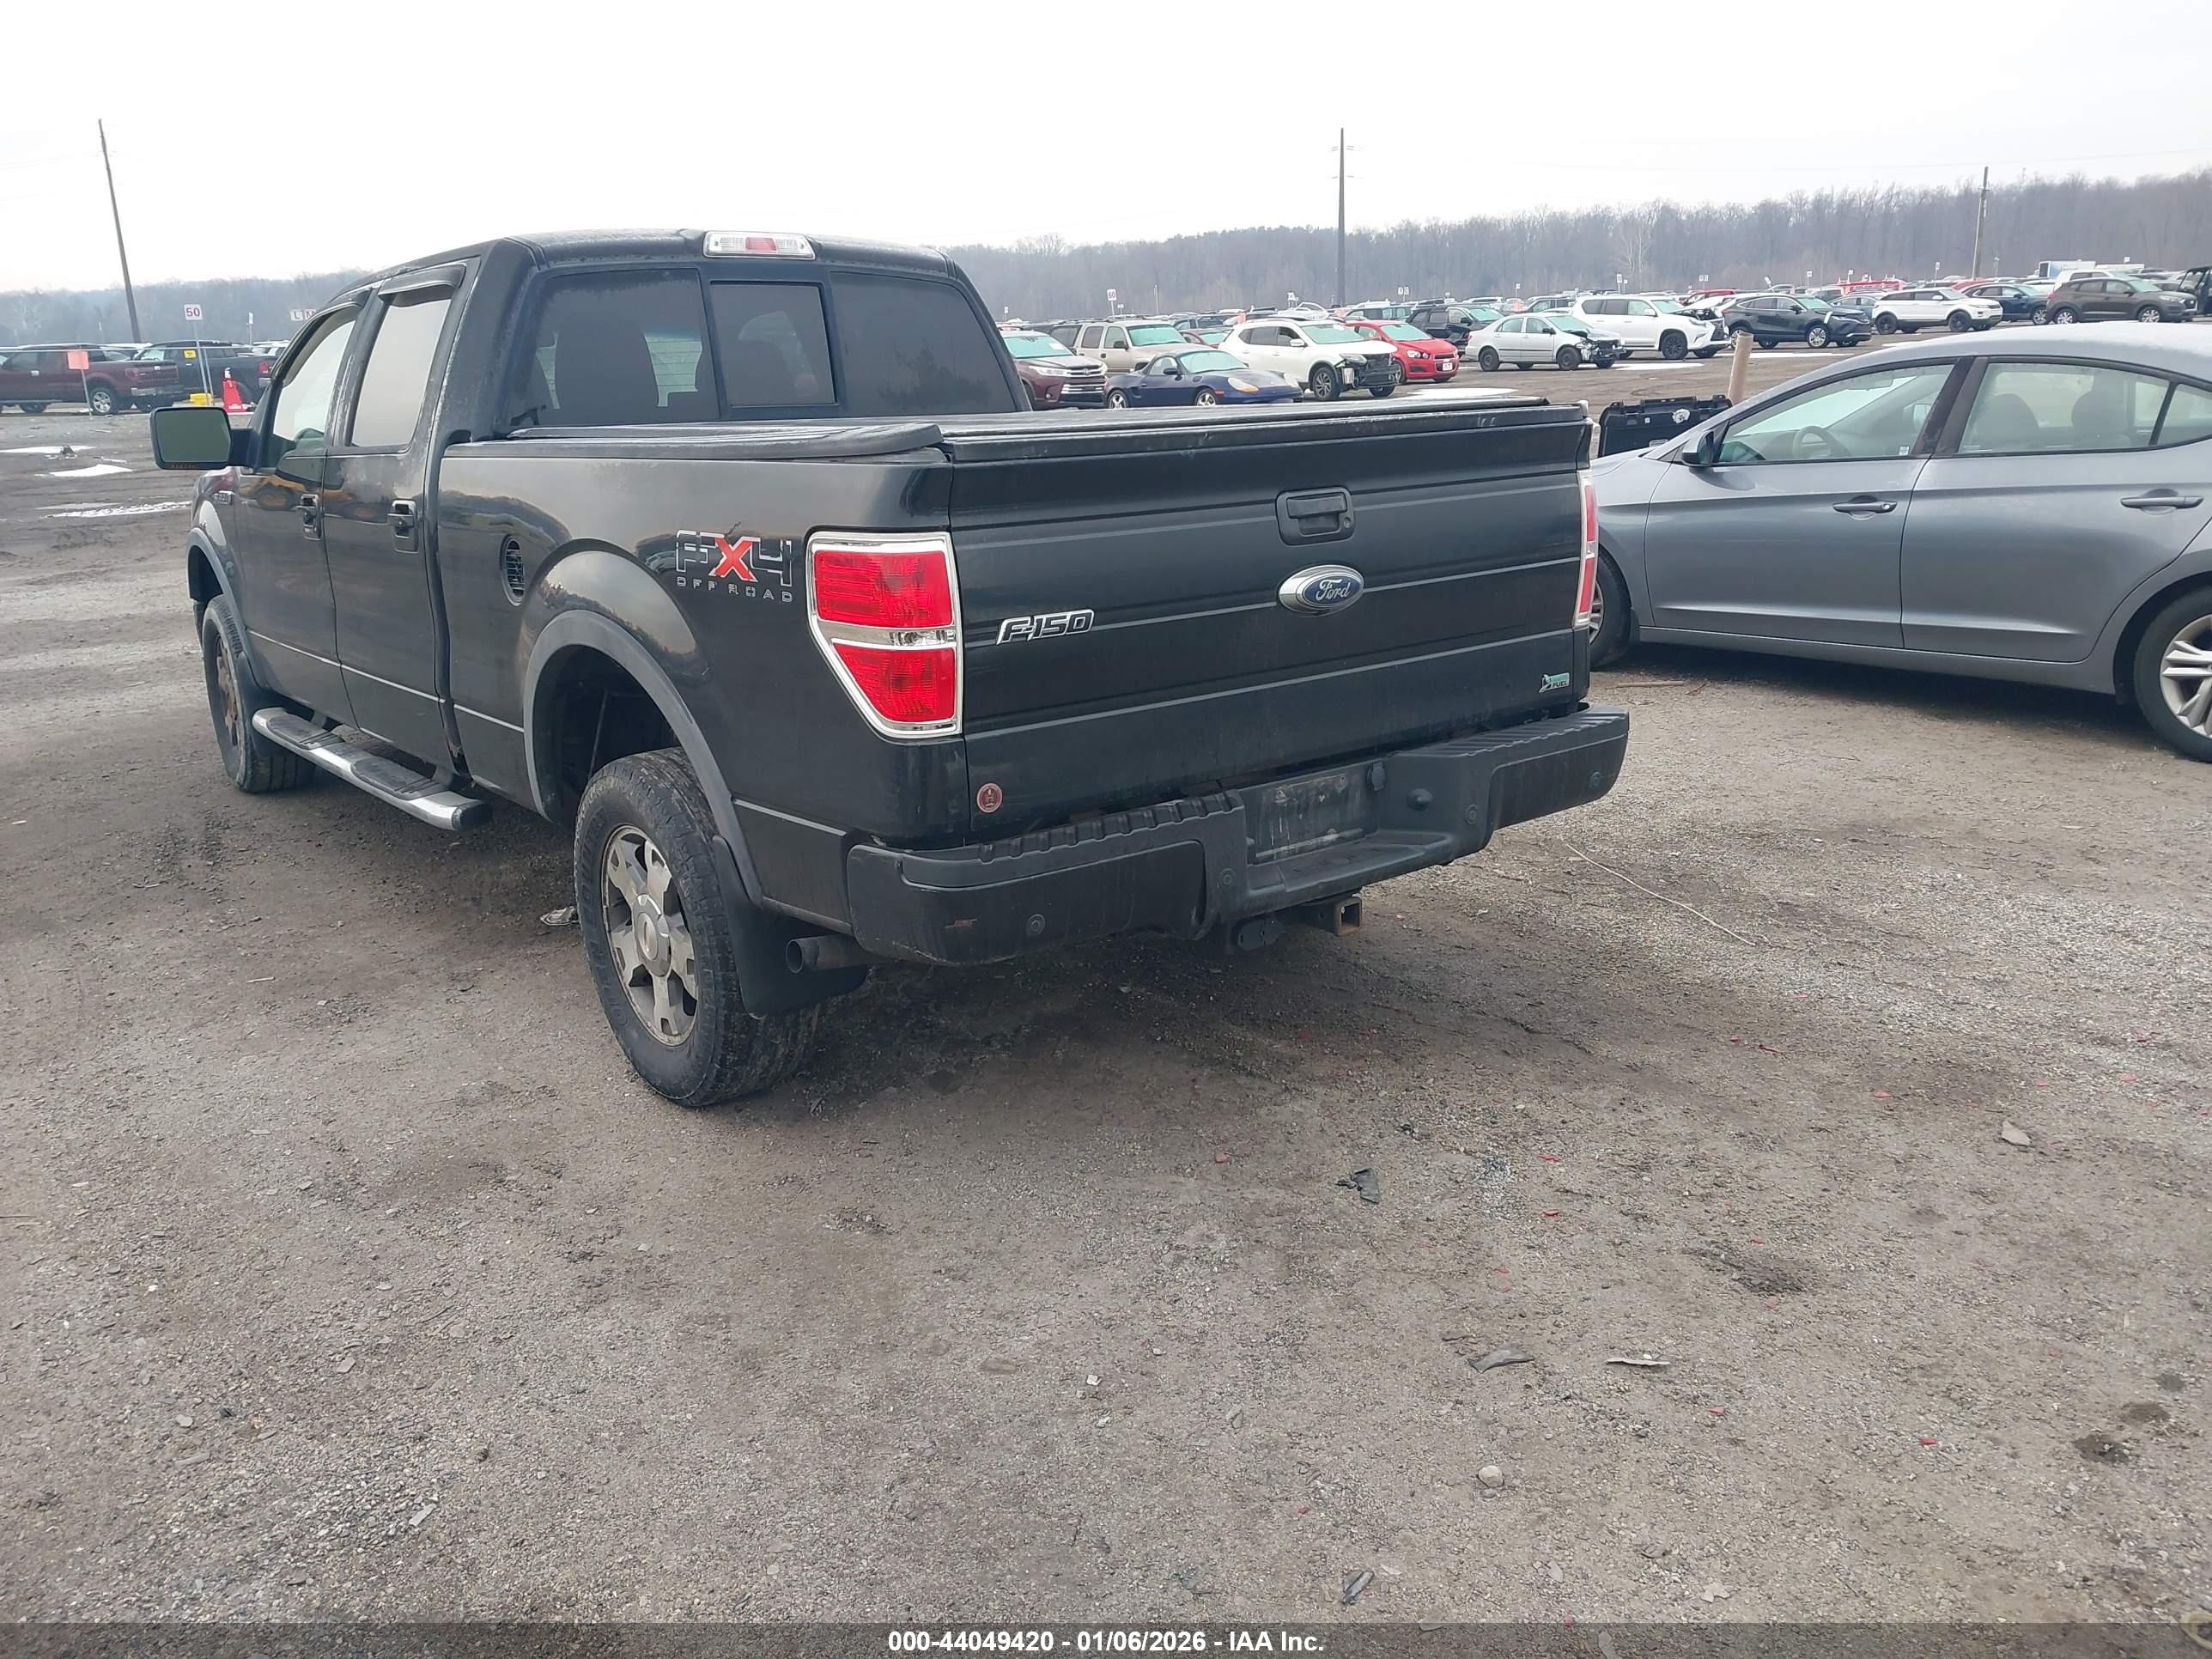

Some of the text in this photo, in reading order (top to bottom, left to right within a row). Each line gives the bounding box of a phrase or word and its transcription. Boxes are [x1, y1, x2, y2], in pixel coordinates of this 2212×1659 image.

[185, 307, 200, 317] 50
[676, 529, 793, 587] FX4
[676, 576, 793, 603] OFF ROAD
[1315, 578, 1352, 601] Ford
[996, 608, 1096, 646] F-150
